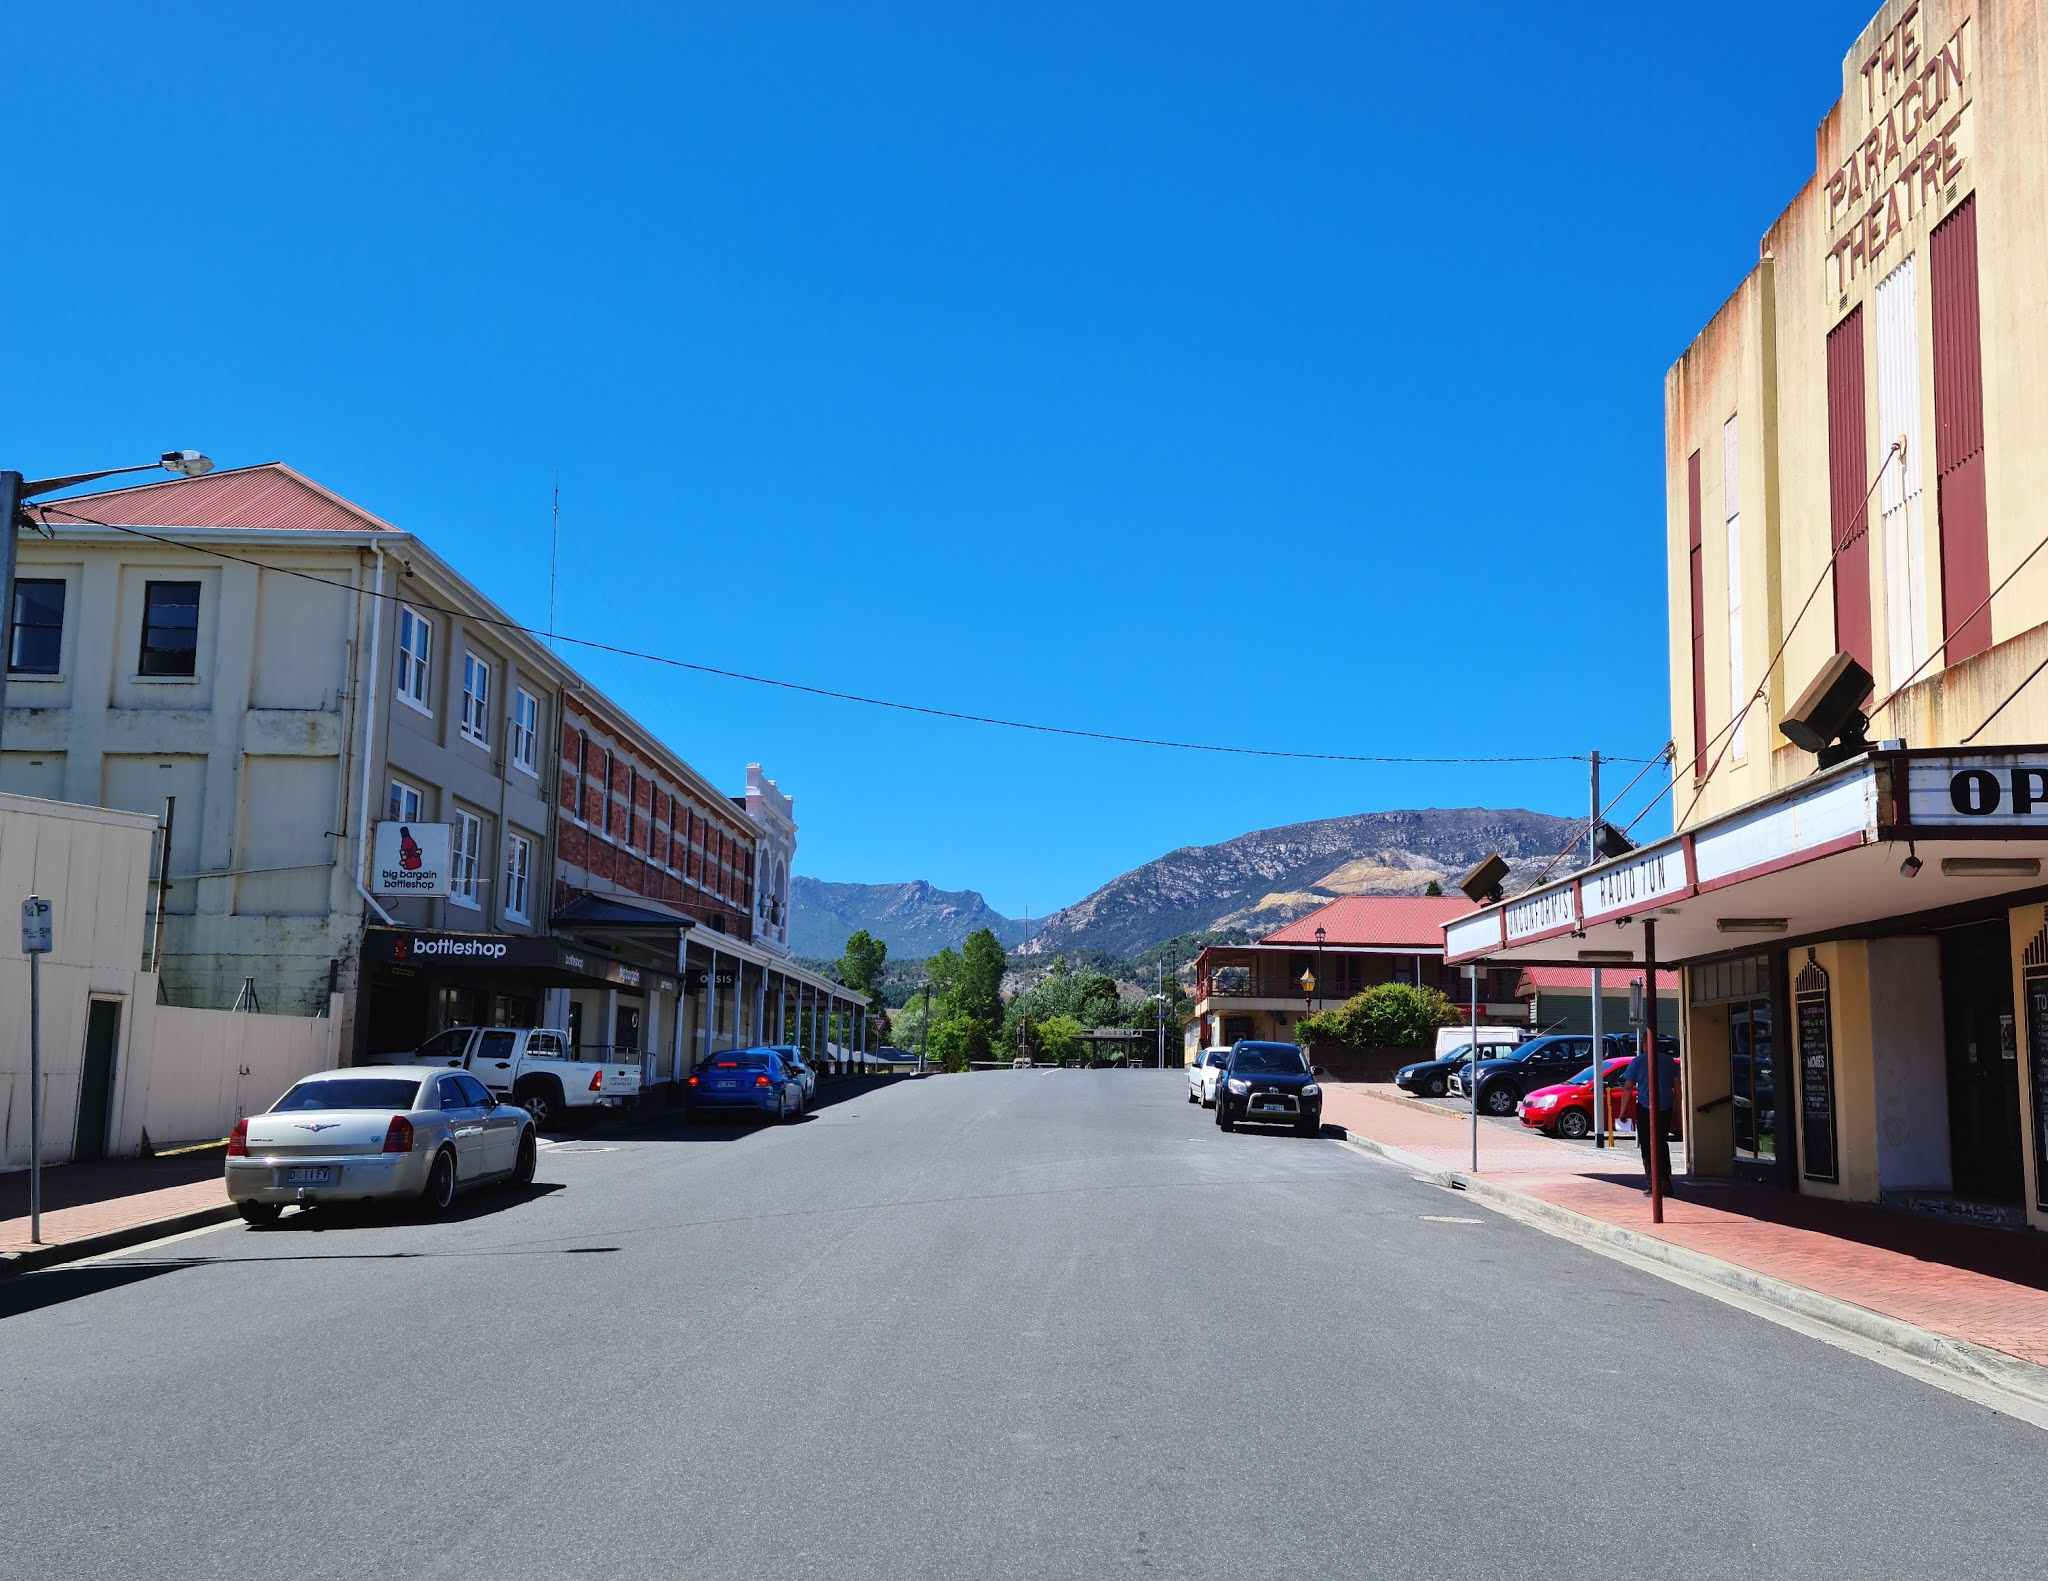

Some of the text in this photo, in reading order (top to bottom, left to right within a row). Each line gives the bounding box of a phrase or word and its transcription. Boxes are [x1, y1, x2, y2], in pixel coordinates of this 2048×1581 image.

[1861, 0, 1922, 112] THE
[1827, 27, 1965, 230] PARAGON
[1830, 115, 1966, 293] THEATRE
[382, 869, 437, 881] big bargain
[384, 879, 435, 891] bottleshop
[1600, 866, 1636, 908] RADIO
[413, 937, 507, 959] bottleshop
[700, 974, 733, 984] OSIS
[609, 1076, 633, 1086] ISUZU
